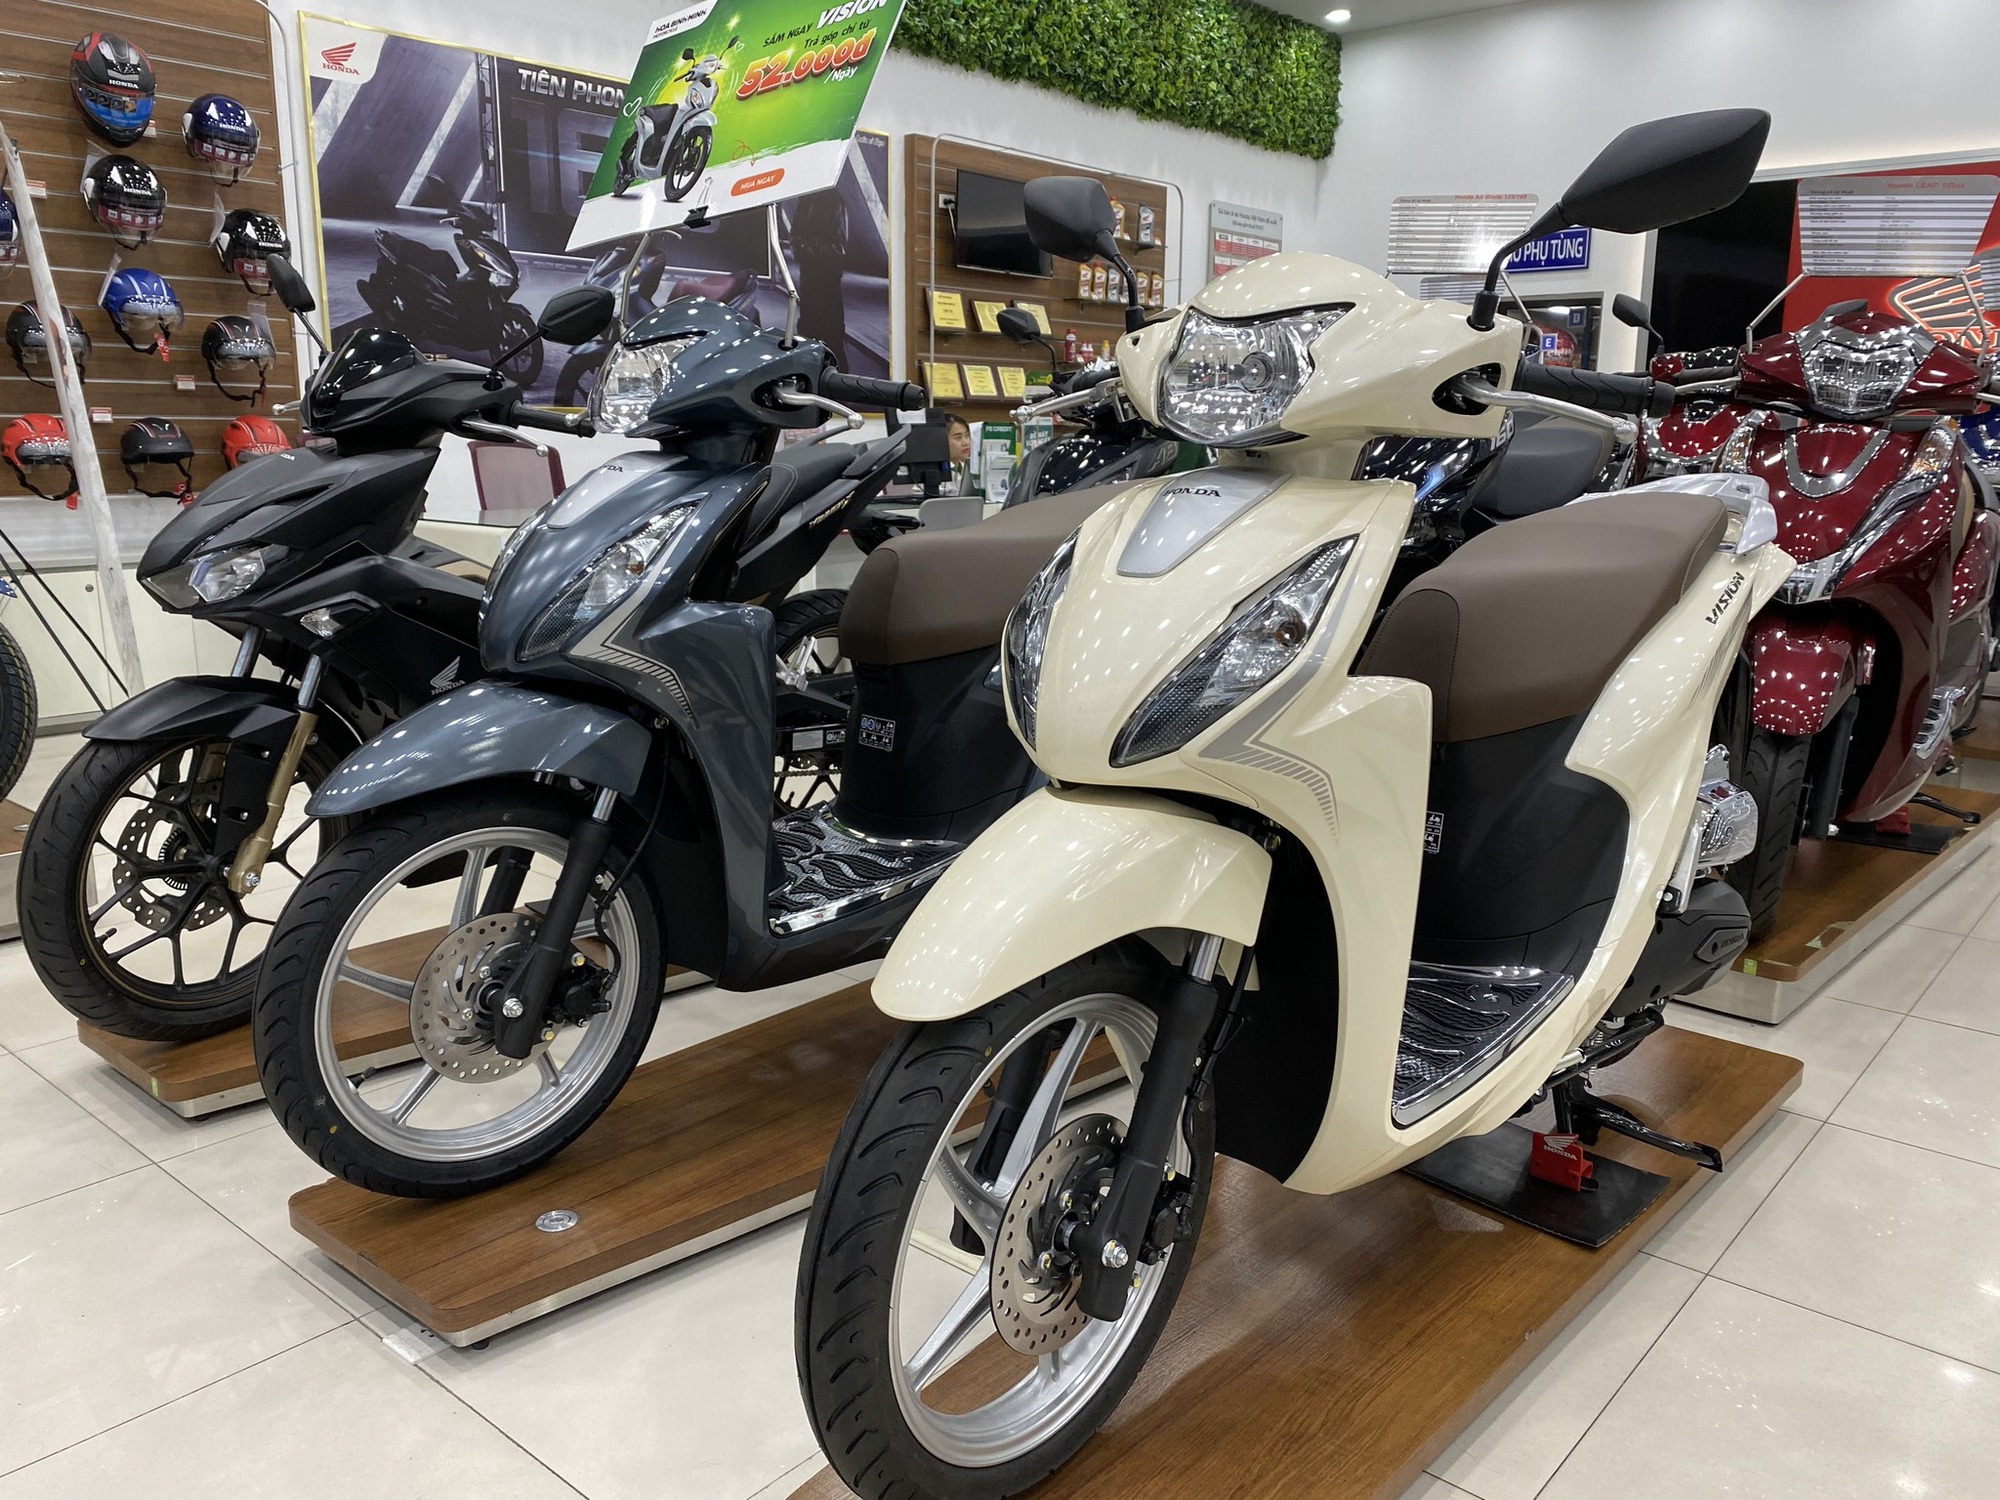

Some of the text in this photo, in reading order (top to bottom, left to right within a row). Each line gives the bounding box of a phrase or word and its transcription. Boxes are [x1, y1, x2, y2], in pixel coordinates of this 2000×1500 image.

[816, 0, 888, 29] VISION
[788, 22, 814, 40] NGAY
[821, 30, 838, 46] góp
[322, 62, 360, 76] HONDA
[108, 79, 139, 89] HONDA
[517, 68, 626, 109] TIÊN PHON
[218, 122, 246, 133] HONDA
[740, 174, 777, 191] MUA NGAY
[123, 186, 152, 196] HONDA
[258, 241, 283, 249] HONDA
[1524, 240, 1549, 266] PHỤ
[1550, 233, 1584, 260] TÙNG
[1545, 337, 1552, 348] E
[1162, 487, 1222, 498] HONDA
[1704, 571, 1745, 625] VISION
[431, 680, 466, 695] HONDA
[1543, 1144, 1578, 1161] HONDA
